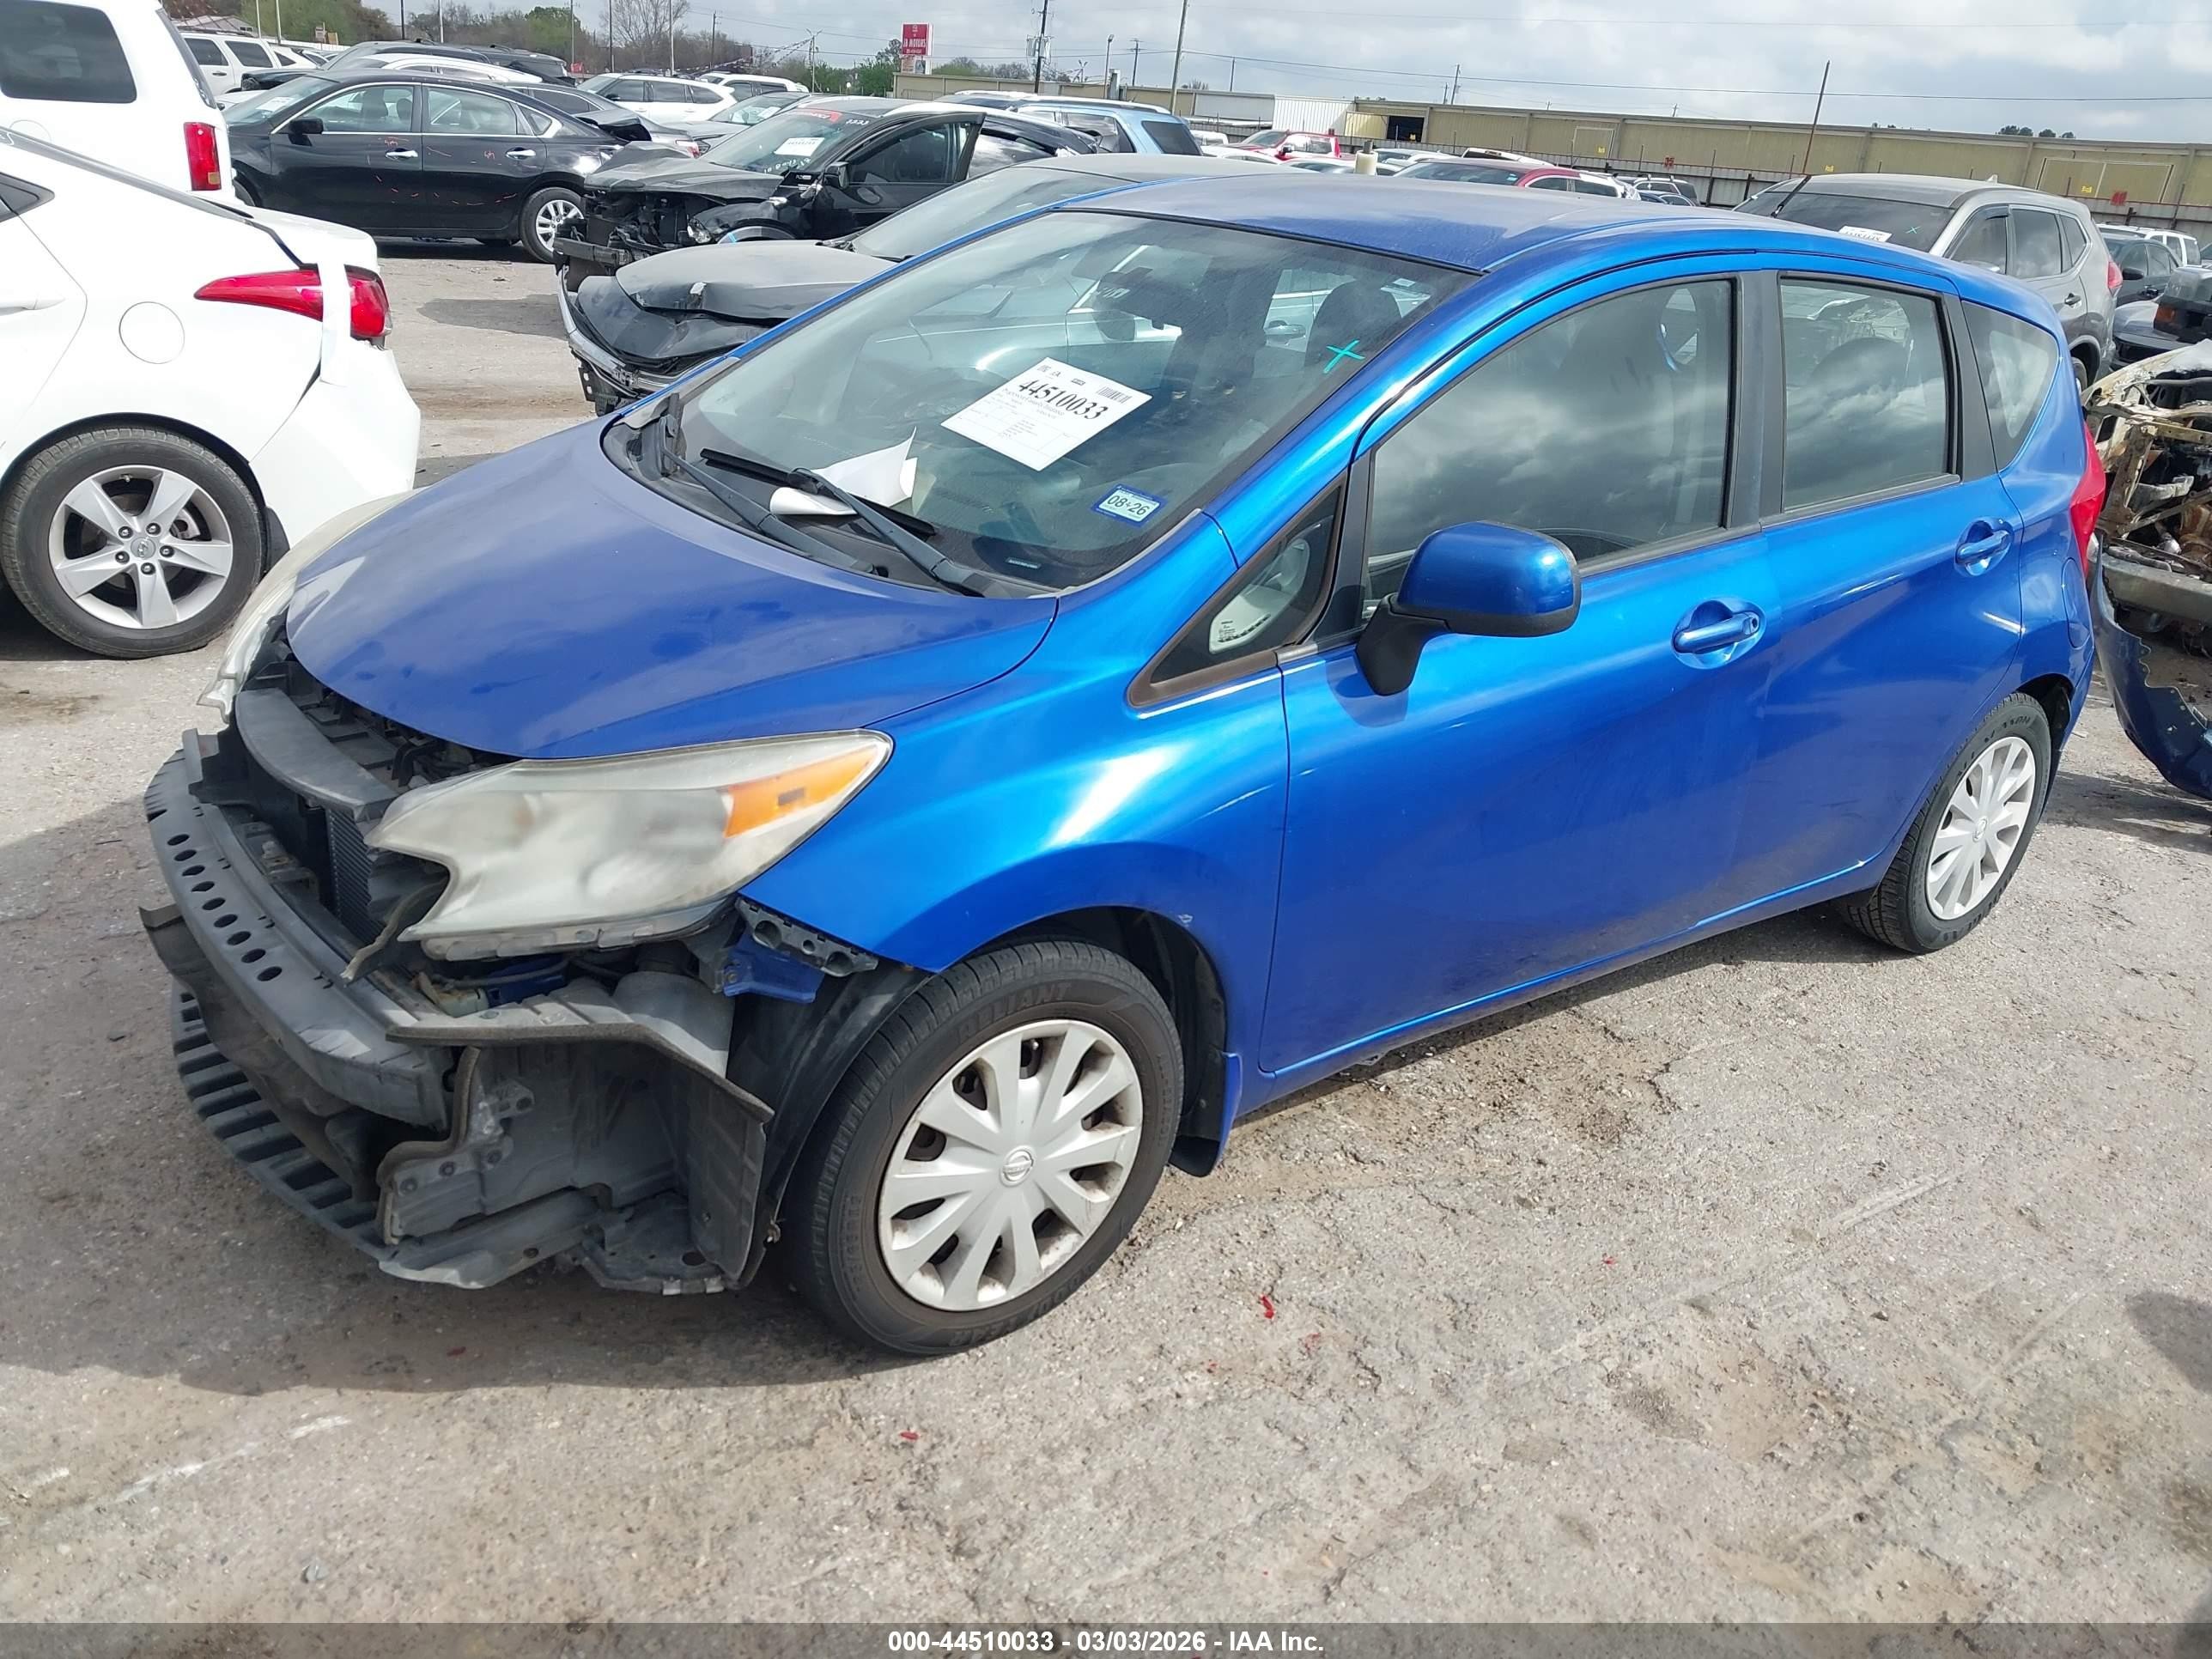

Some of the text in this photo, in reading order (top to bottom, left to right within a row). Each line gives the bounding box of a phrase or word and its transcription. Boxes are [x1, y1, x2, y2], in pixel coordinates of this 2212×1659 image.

[1018, 379, 1109, 420] 44510033
[1107, 495, 1128, 508] 08
[1127, 501, 1151, 516] 26
